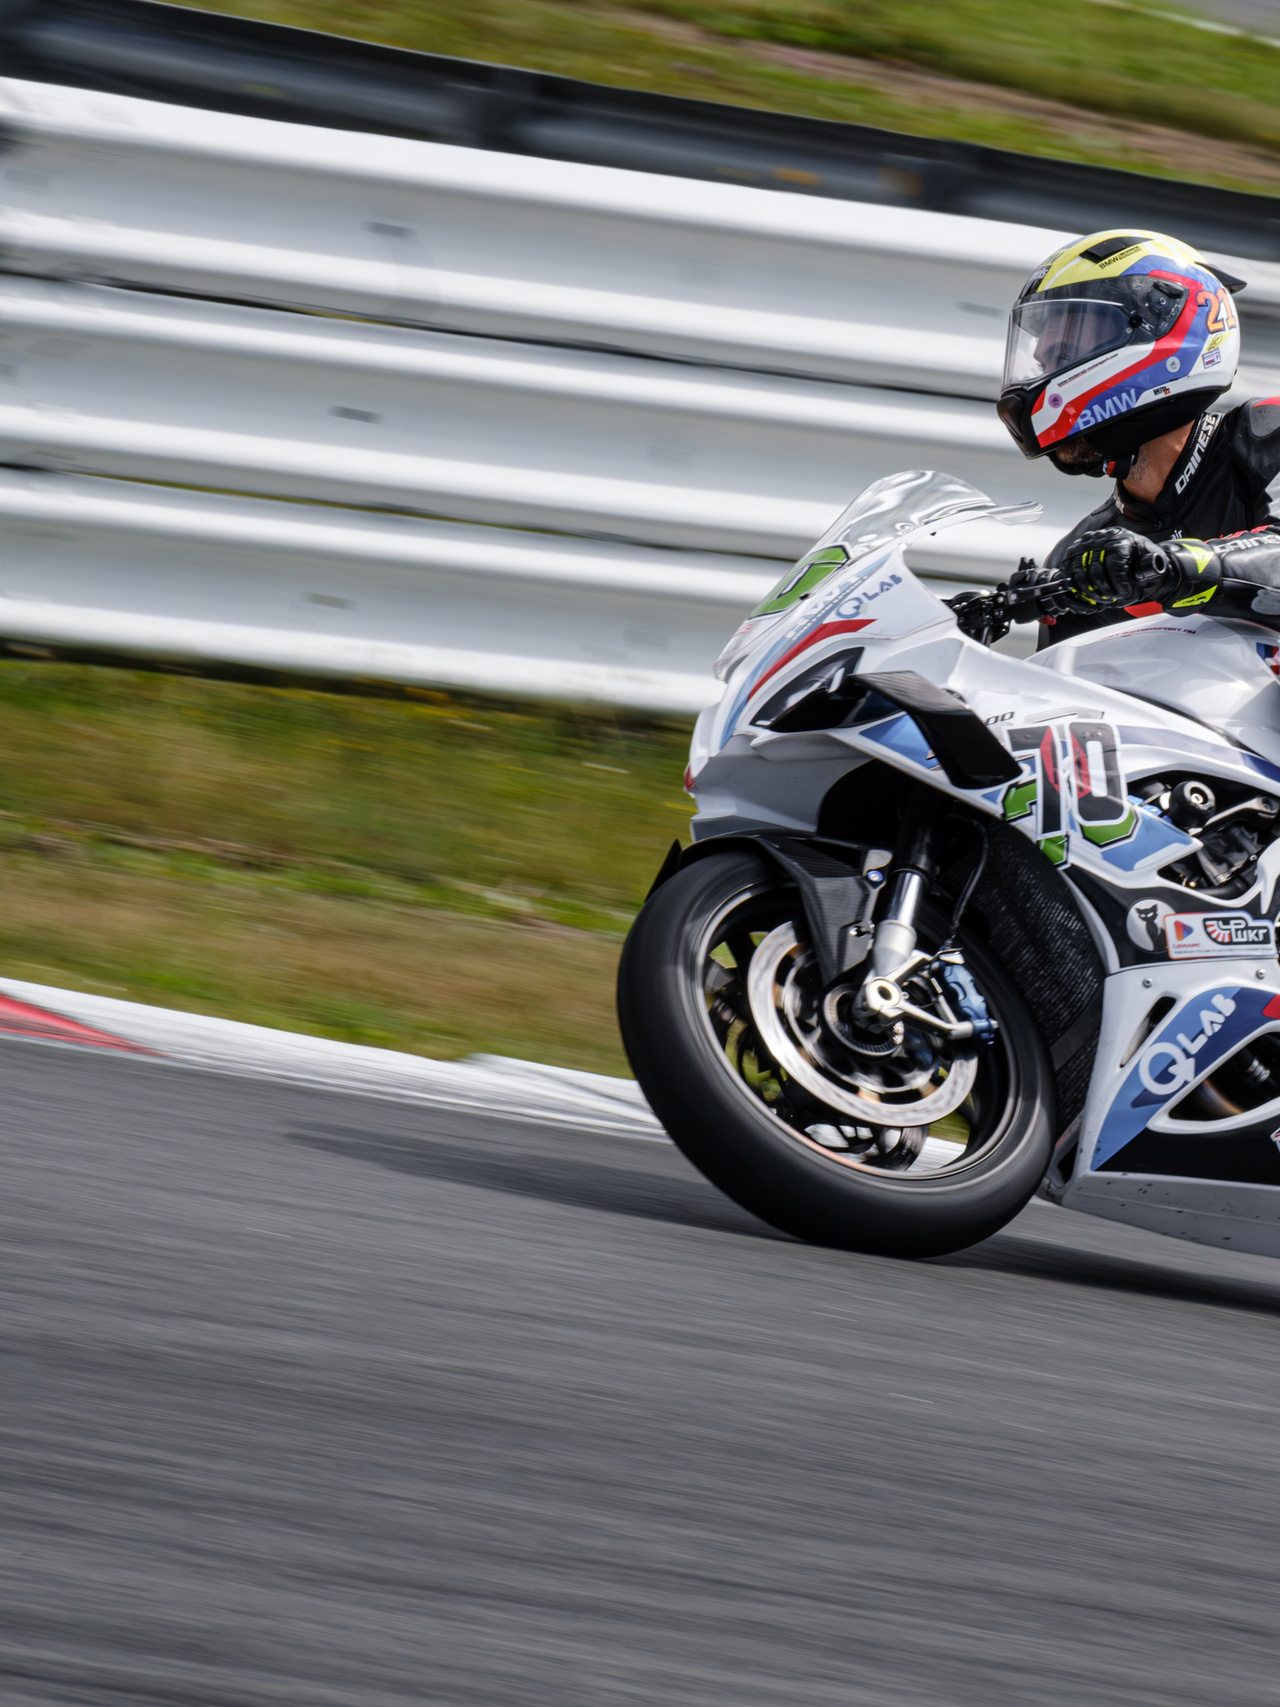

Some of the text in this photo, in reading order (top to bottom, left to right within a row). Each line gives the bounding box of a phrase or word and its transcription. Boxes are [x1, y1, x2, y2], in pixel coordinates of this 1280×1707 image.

[1099, 256, 1119, 270] BMW
[1195, 287, 1236, 334] 21
[1079, 388, 1137, 431] BMW
[1174, 414, 1217, 495] DAINESE
